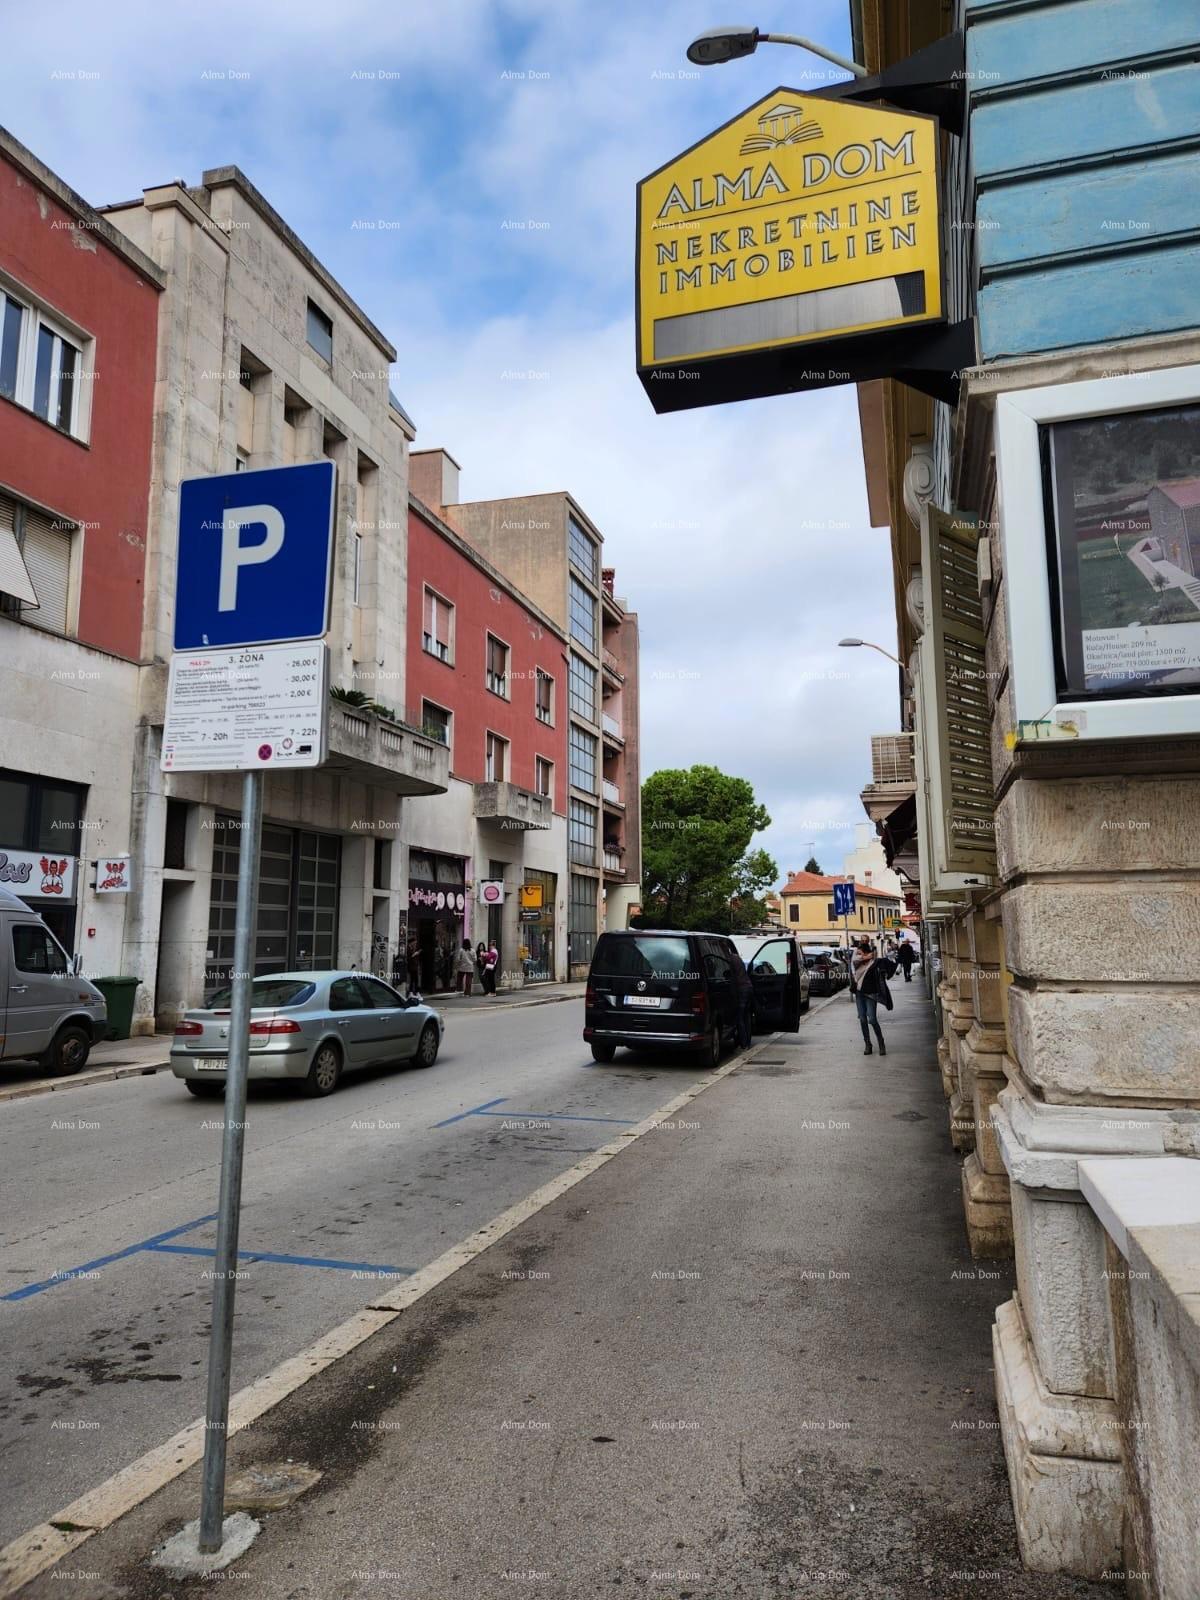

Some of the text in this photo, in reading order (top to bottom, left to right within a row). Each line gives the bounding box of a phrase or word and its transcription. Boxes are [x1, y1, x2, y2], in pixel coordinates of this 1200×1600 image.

[657, 130, 915, 219] ALMA DOM
[656, 190, 921, 266] NEKRETNINE
[659, 222, 917, 295] IMMOBILIEN
[217, 503, 286, 612] P
[228, 654, 264, 664] 3. ZONA
[311, 658, 317, 666] €
[311, 674, 317, 682] €
[213, 732, 228, 741] 20h
[289, 728, 295, 736] 7
[301, 727, 317, 736] 22h
